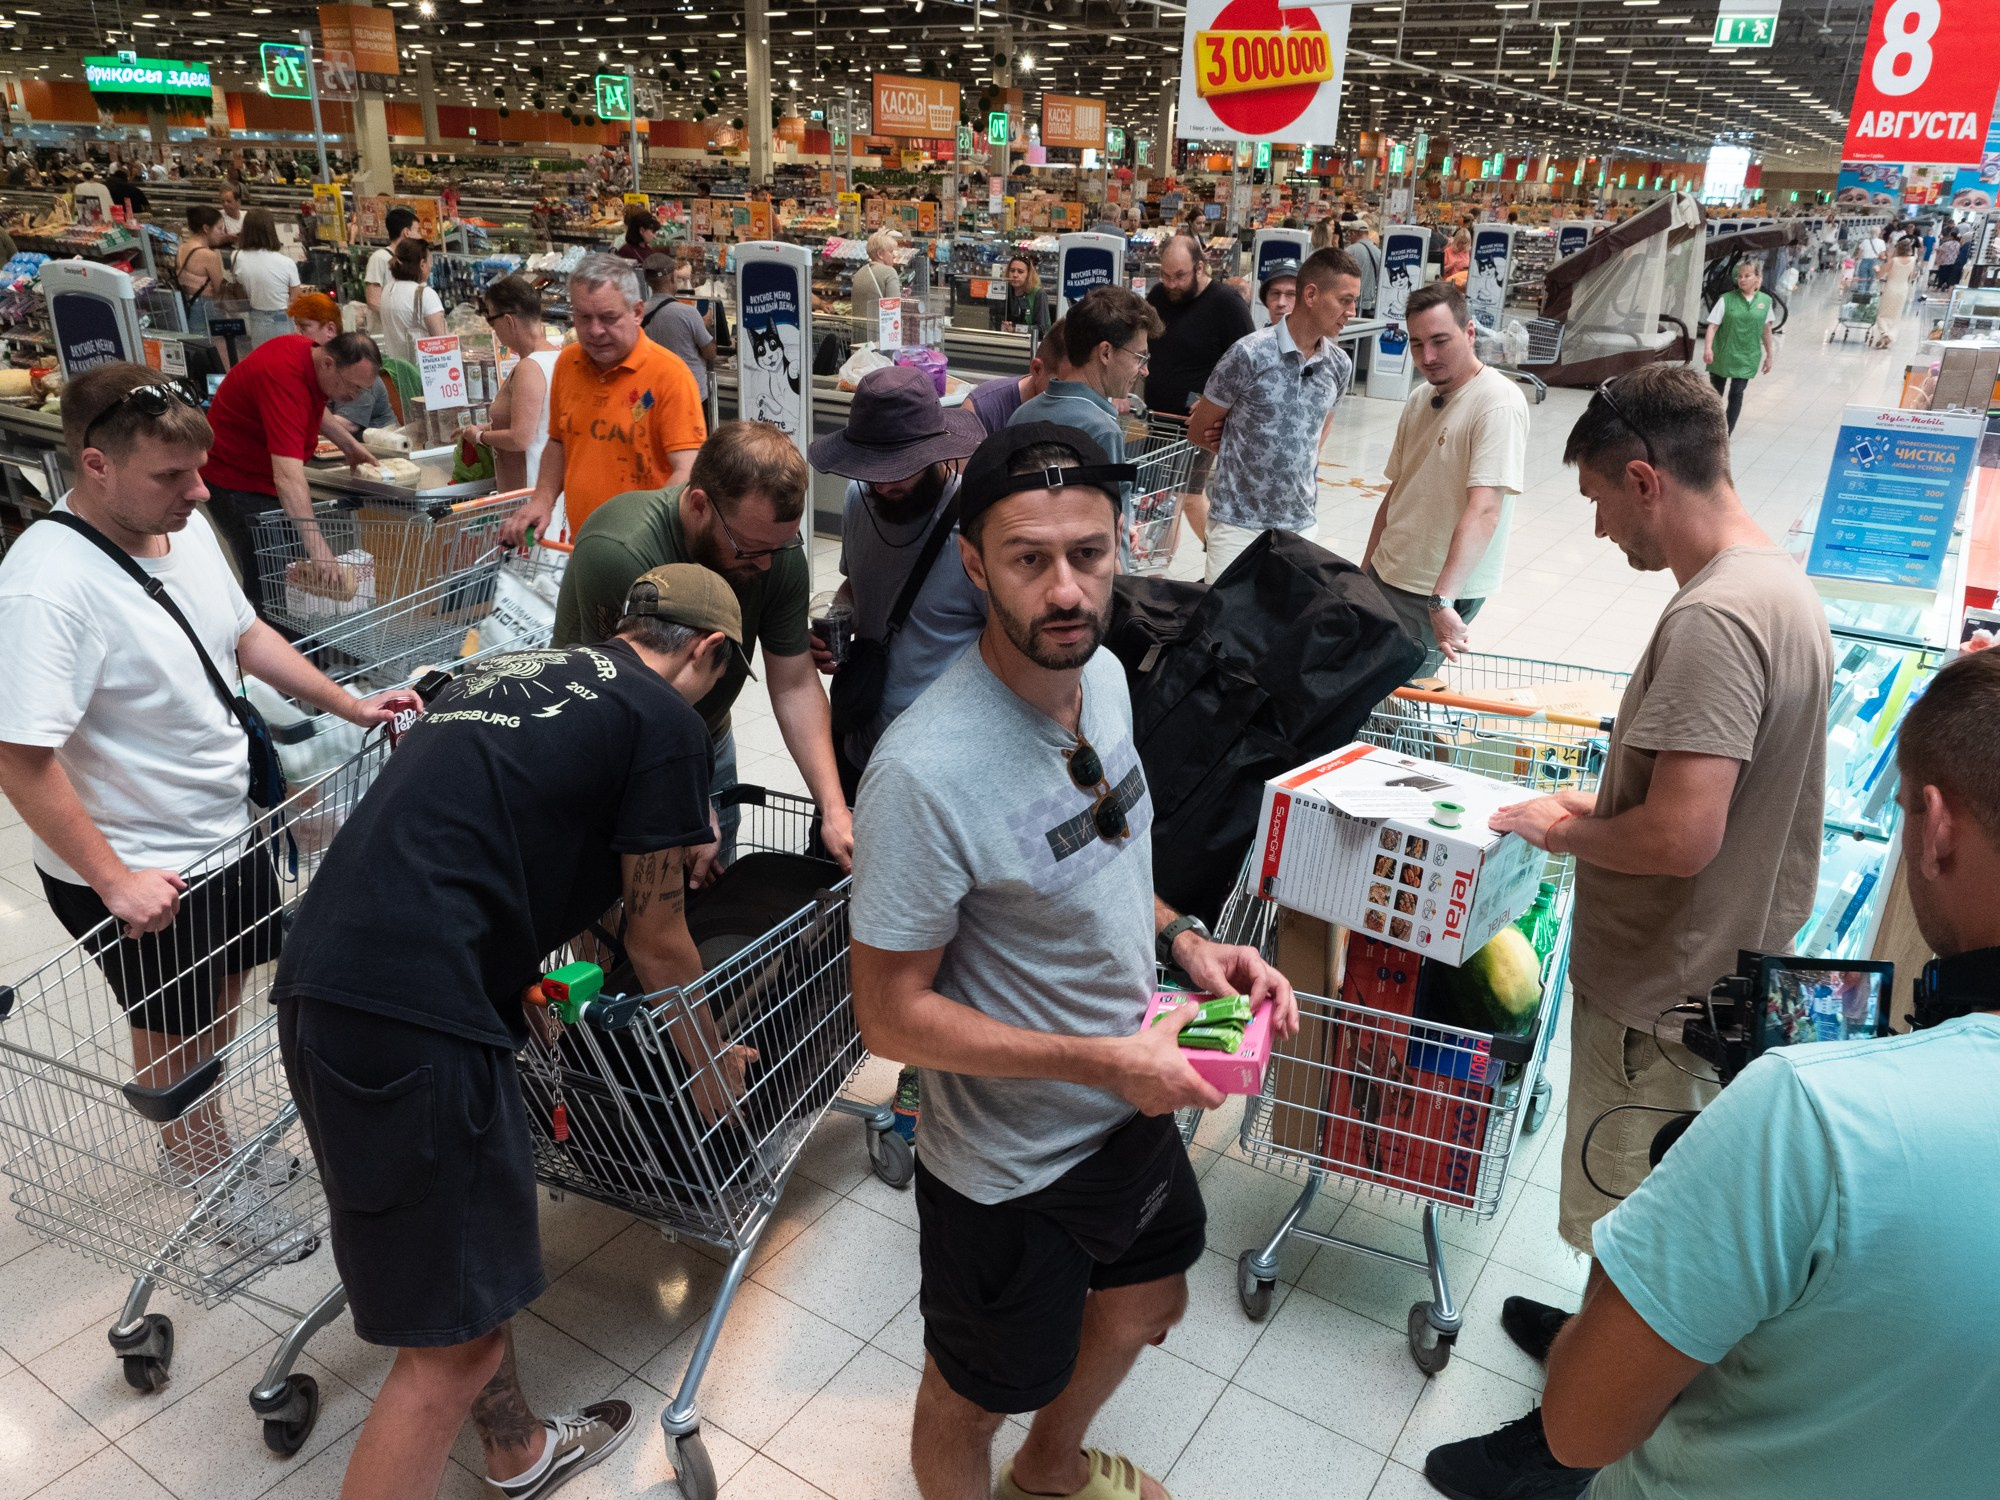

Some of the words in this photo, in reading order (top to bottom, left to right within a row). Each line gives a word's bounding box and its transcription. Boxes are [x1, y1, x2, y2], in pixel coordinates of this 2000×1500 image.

[1872, 0, 1942, 96] 8
[1206, 37, 1228, 86] 3
[1232, 36, 1285, 83] 000
[1286, 36, 1326, 76] 000
[880, 90, 927, 115] КАССЫ
[1047, 108, 1073, 122] КАССЫ
[1047, 122, 1071, 135] ОПЛАТЫ
[1856, 111, 1978, 140] АВГУСТА
[1066, 279, 1074, 287] НА
[1073, 277, 1096, 286] КАЖДЫЙ
[1070, 270, 1092, 280] ВКУСНОЕ
[1091, 268, 1107, 278] МЕНЮ
[749, 291, 773, 304] ВКУСНОЕ
[773, 290, 791, 302] МЕНЮ
[745, 305, 754, 314] НА
[754, 301, 778, 314] КАЖДЫЙ
[70, 339, 96, 357] ВКУСНОЕ
[94, 338, 116, 354] МЕНЮ
[440, 384, 459, 398] 109
[1896, 440, 1960, 450] ПРОФЕССИОНАЛЬНАЯ
[1895, 447, 1957, 464] ЧИСТКА
[565, 681, 599, 700] 2017
[426, 710, 521, 728] PETERSBURG
[1267, 806, 1286, 863] SuperGrill
[1441, 868, 1475, 941] Tefal
